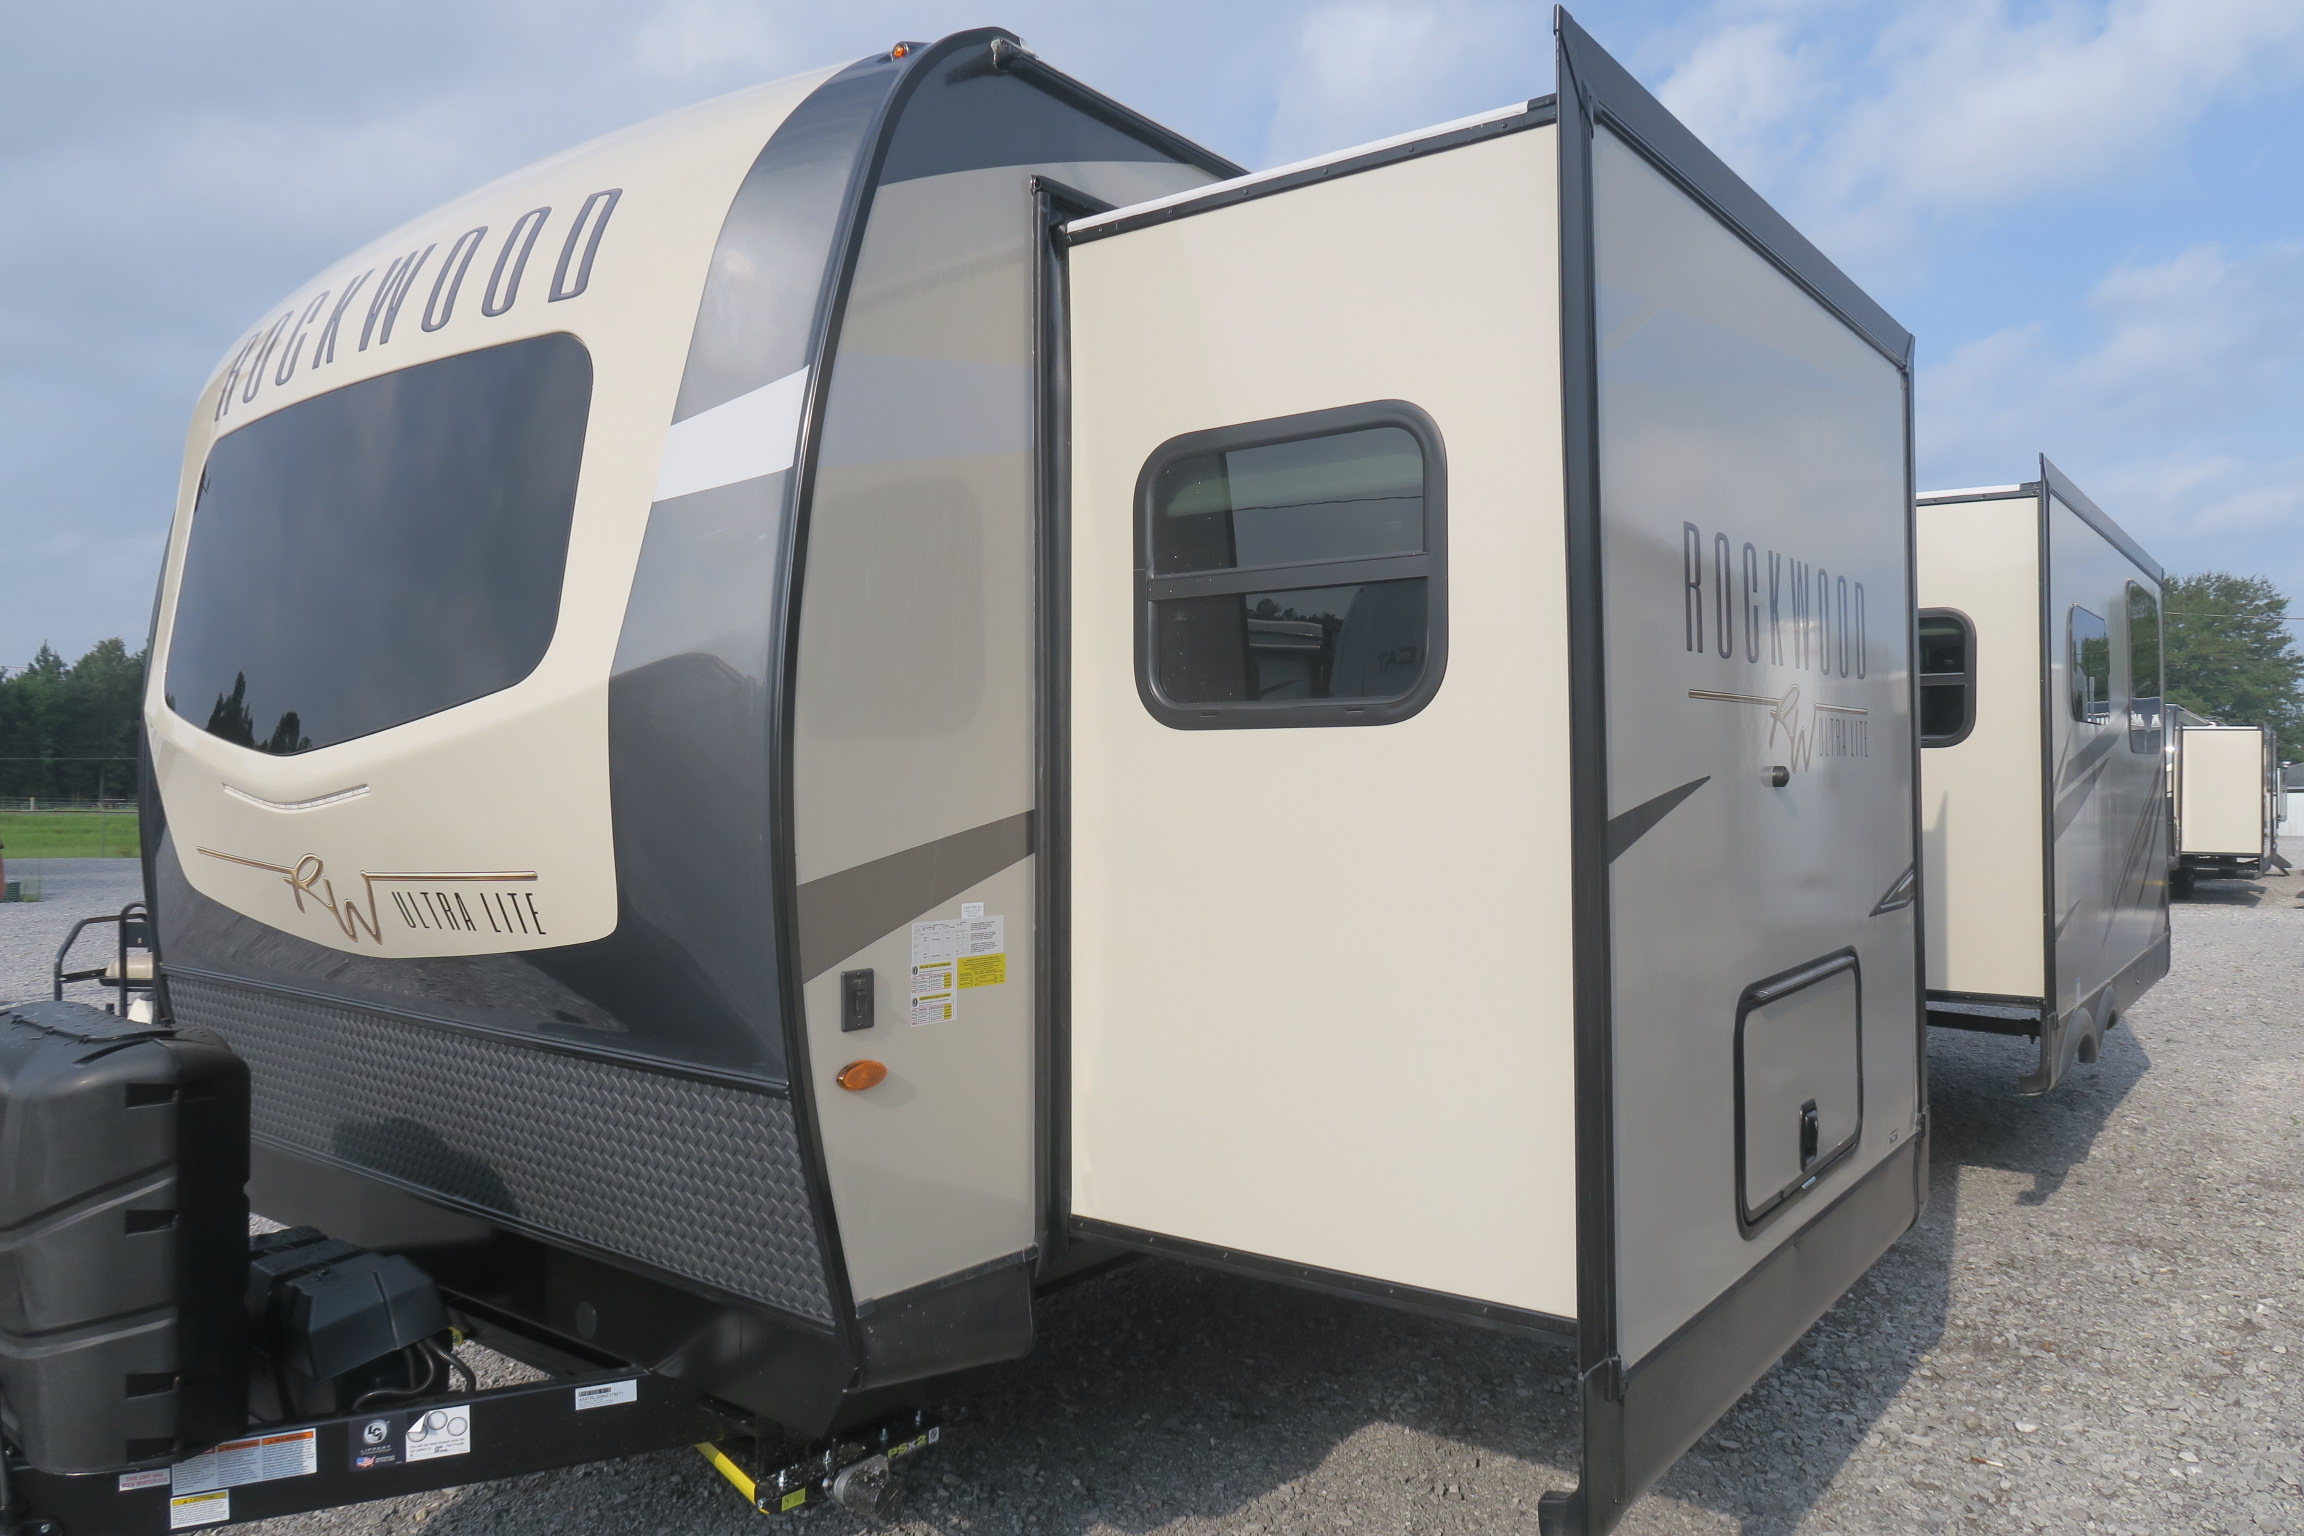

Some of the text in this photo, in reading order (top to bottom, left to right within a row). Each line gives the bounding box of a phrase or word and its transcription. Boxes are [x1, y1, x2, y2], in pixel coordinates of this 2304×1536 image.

[214, 188, 623, 422] ROCKWOOD
[1683, 520, 1866, 680] ROCKWOOD
[1818, 716, 1869, 758] ULTRA LITE
[391, 891, 547, 935] ULTRA LITE
